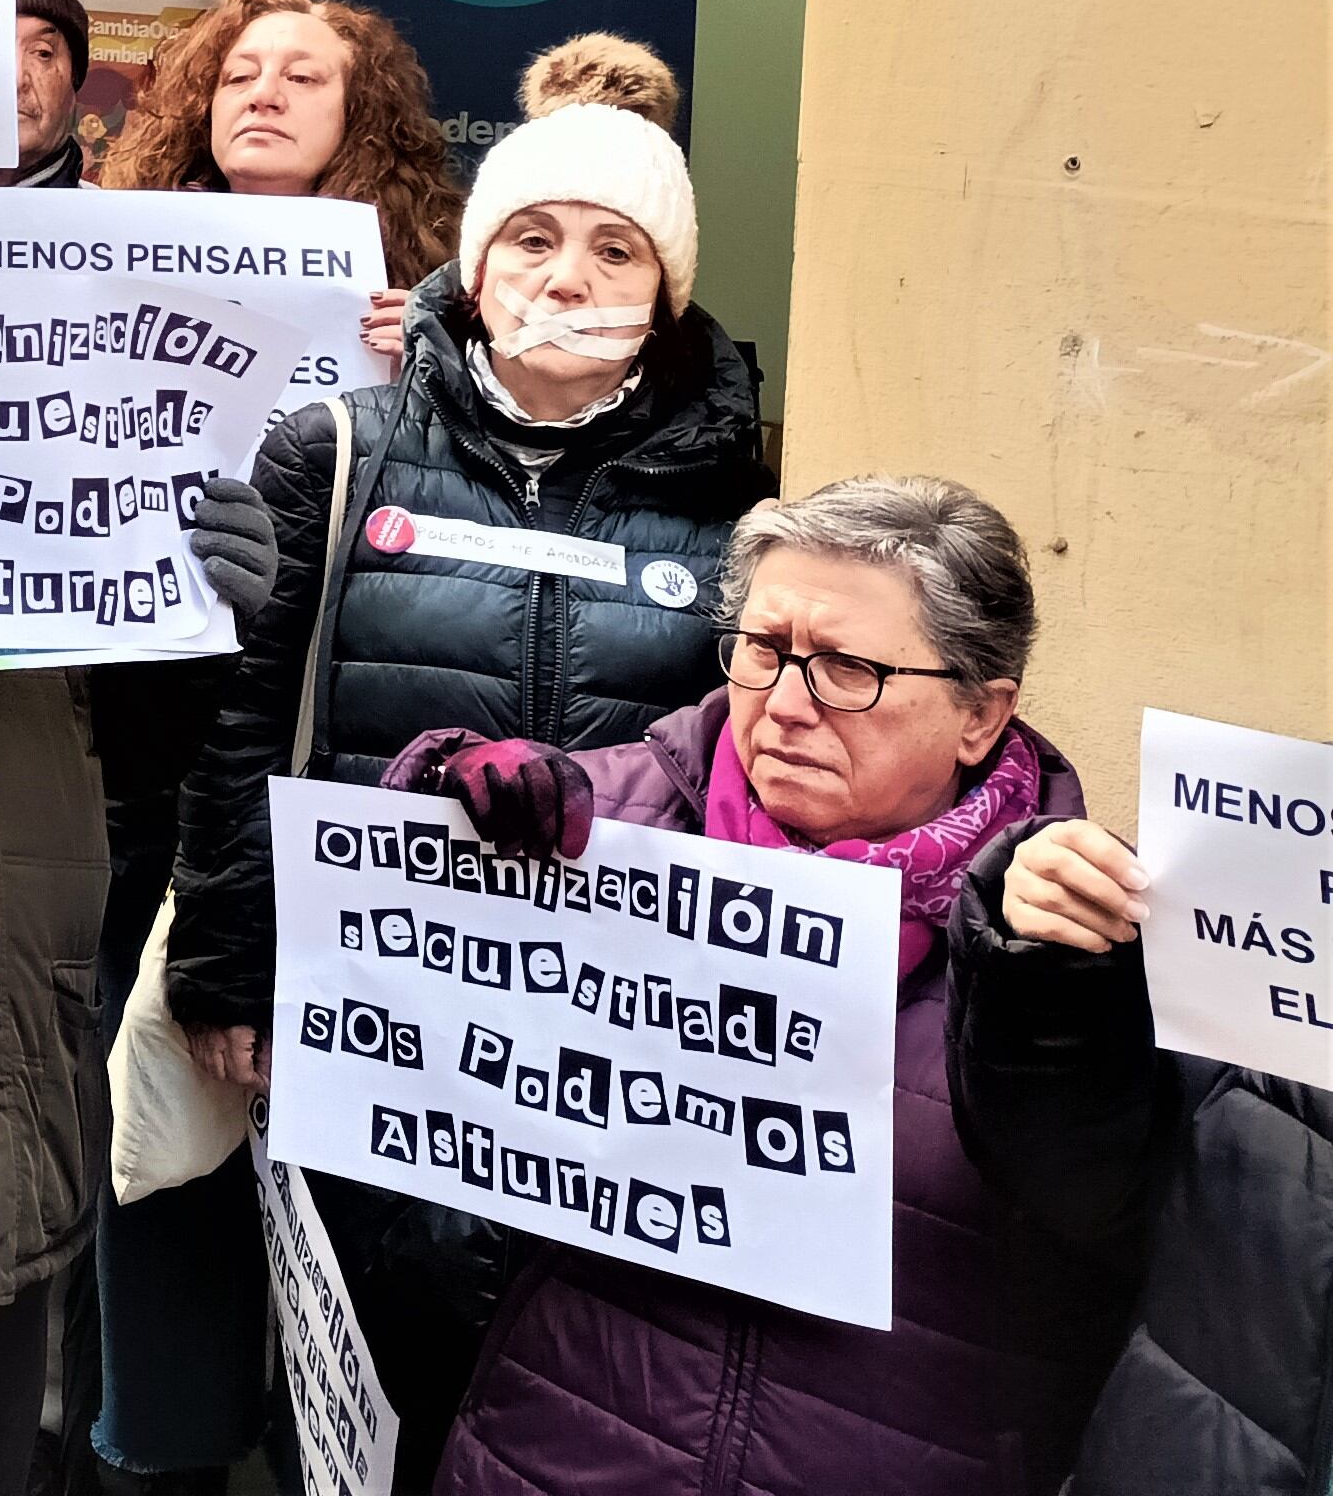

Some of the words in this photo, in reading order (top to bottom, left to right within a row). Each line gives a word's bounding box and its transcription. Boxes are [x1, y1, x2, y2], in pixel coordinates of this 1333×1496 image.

[127, 243, 287, 277] PENSAR
[301, 249, 352, 278] EN
[1173, 772, 1333, 838] MENO
[340, 907, 822, 1067] secuestrada
[1193, 908, 1315, 964] MÁS
[459, 1022, 855, 1176] Podemos
[371, 1104, 731, 1253] Asturies
